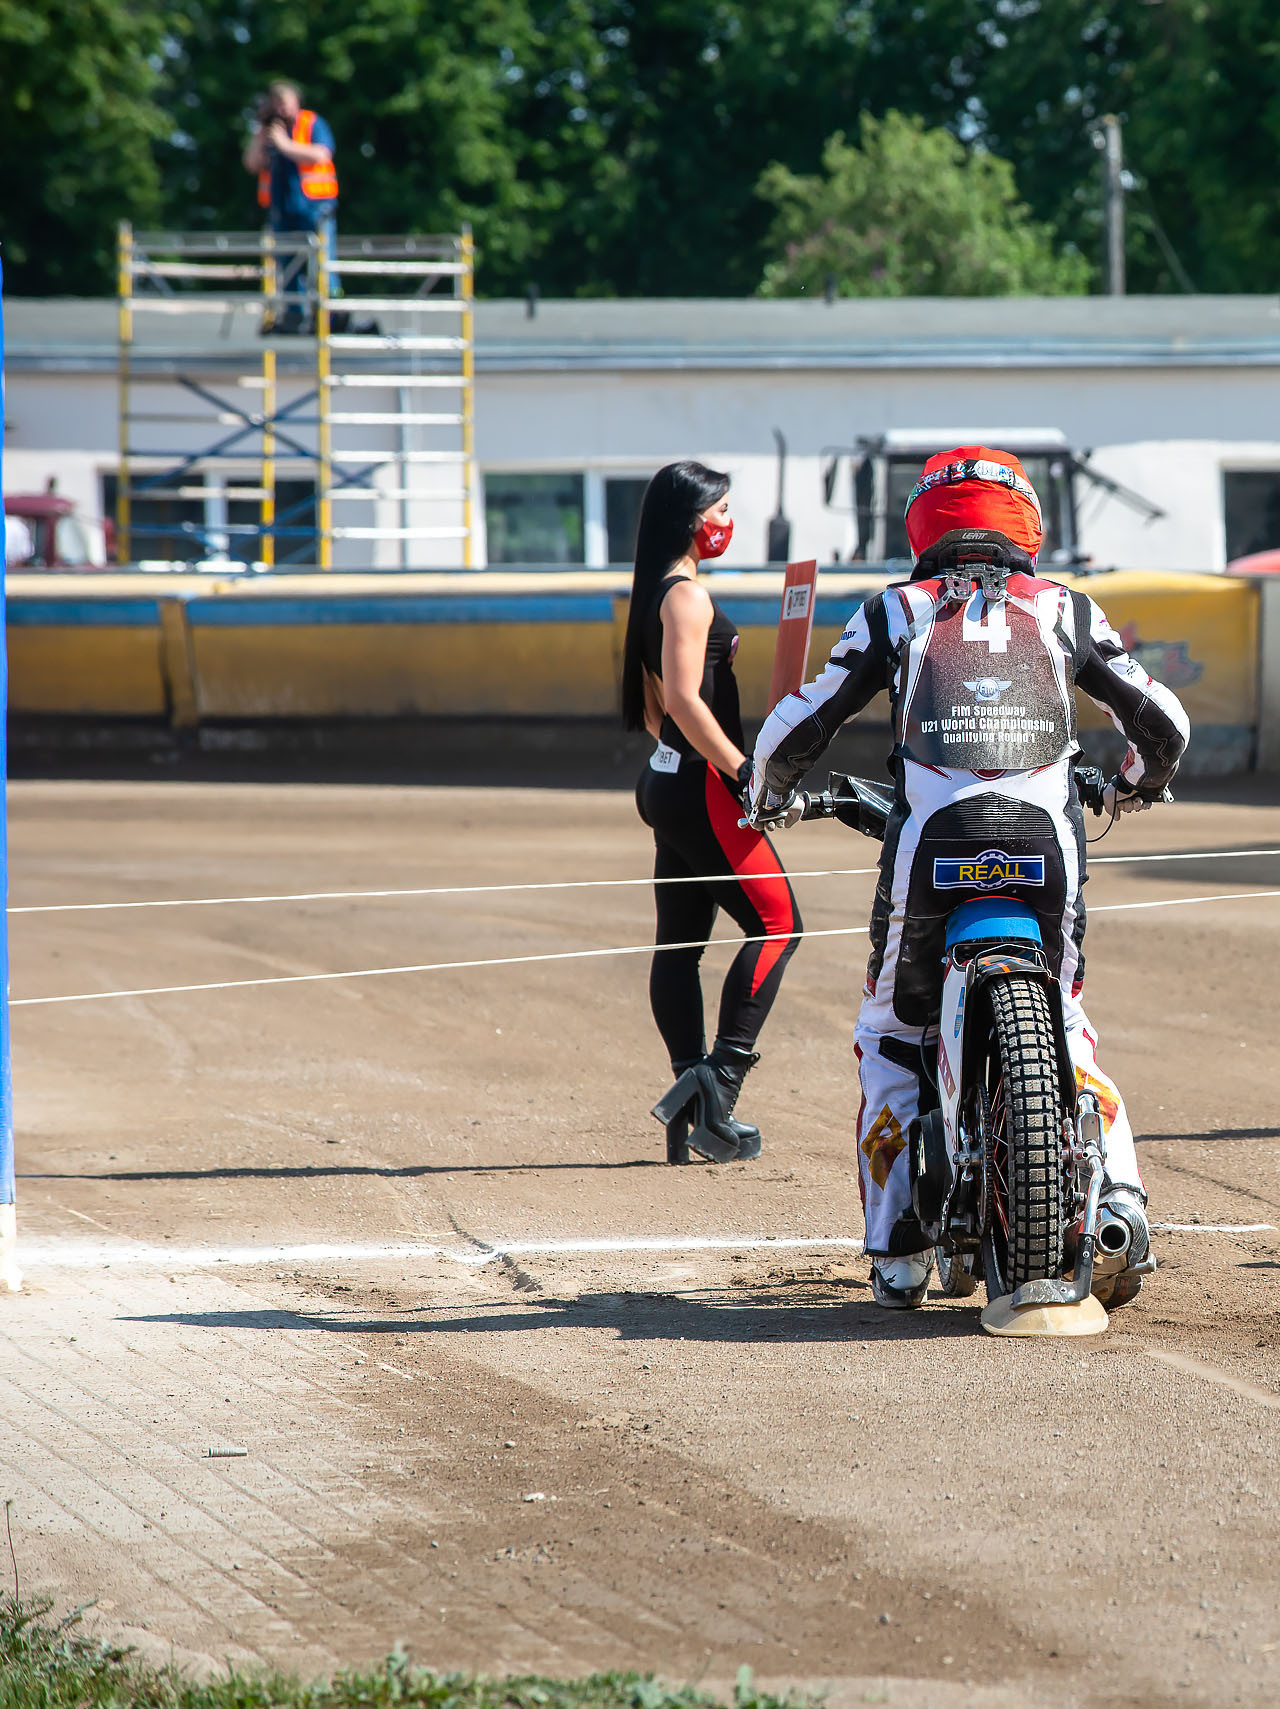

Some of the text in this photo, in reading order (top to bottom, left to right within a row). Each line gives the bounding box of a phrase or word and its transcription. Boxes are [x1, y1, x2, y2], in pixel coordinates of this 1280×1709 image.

[961, 532, 989, 540] LEATT
[962, 588, 1012, 654] 4
[951, 705, 1026, 717] FIM Speedway
[921, 718, 1055, 733] U21 World Championship
[943, 732, 995, 744] Qualifying
[997, 732, 1030, 743] Round
[959, 863, 1026, 881] REALL
